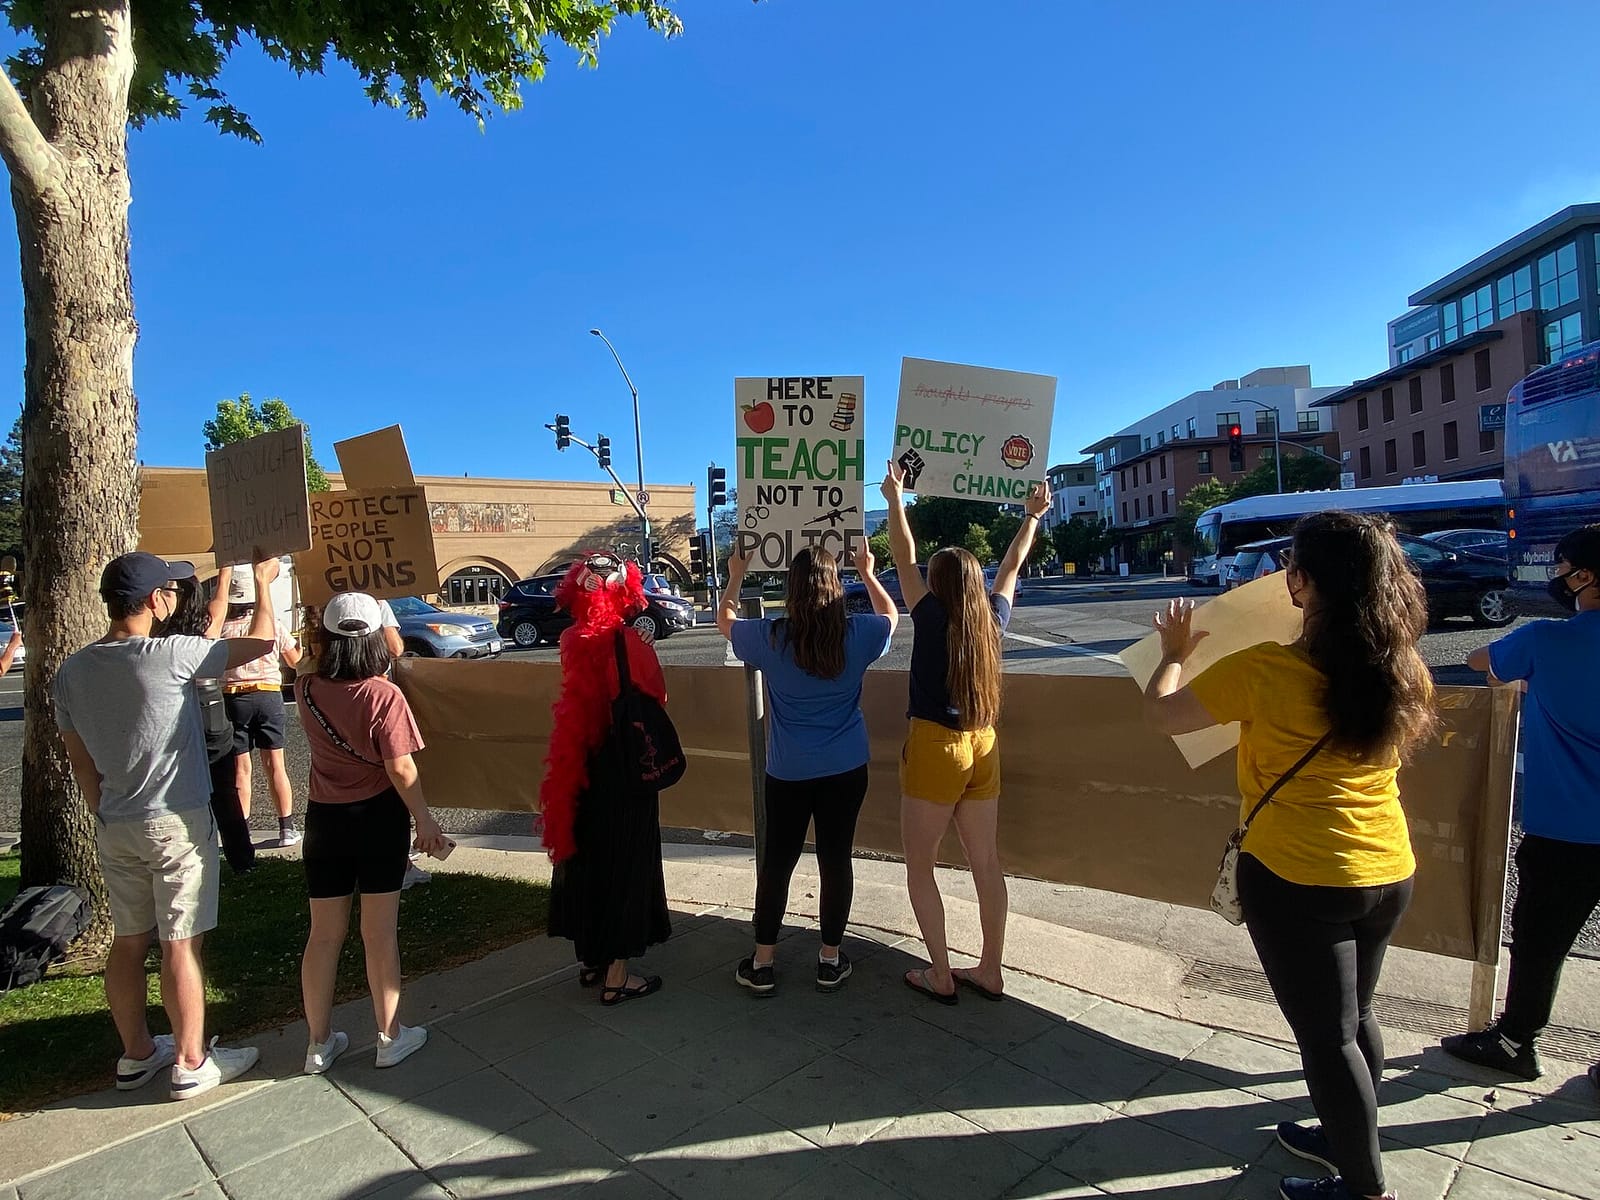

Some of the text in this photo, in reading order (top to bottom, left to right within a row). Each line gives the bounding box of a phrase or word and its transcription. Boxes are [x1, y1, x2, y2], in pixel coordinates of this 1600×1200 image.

[767, 377, 833, 400] HERE
[783, 404, 814, 426] TO
[896, 424, 985, 457] POLICY
[1008, 445, 1028, 458] VOTE
[215, 437, 298, 490] ENOUGH
[736, 437, 864, 480] TEACH
[311, 494, 418, 520] ROTECT
[757, 485, 844, 507] NOT TO
[222, 504, 300, 551] ENOUGH
[327, 537, 394, 563] NOT
[1523, 551, 1549, 565] Hybrid
[325, 560, 416, 592] GUNS
